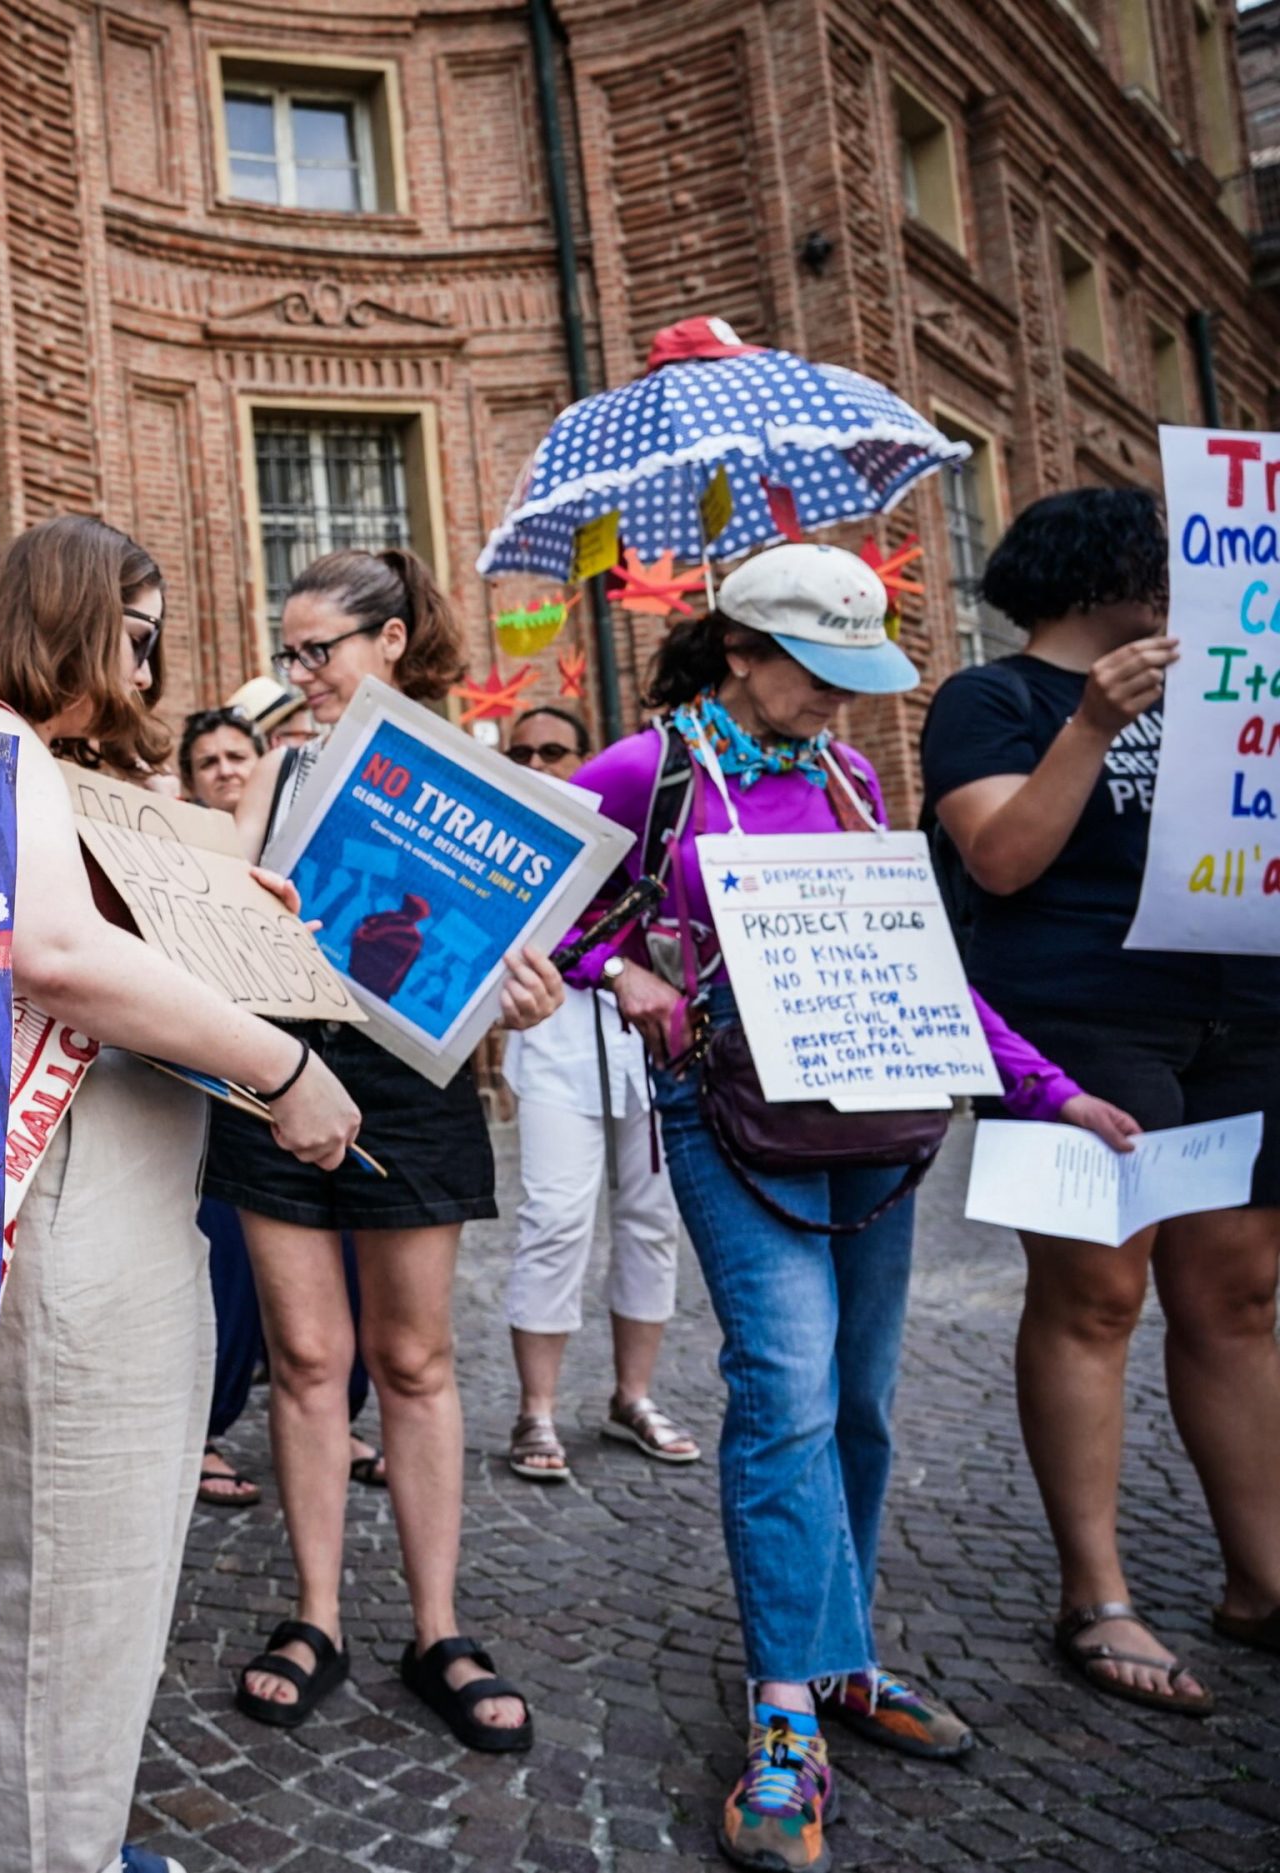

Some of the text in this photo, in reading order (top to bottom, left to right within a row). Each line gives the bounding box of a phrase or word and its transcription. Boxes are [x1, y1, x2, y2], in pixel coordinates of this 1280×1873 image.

[361, 752, 553, 887] NO TYRANTS
[78, 784, 210, 895] NO
[352, 785, 533, 903] GLOBAL DAY OF DEFIANCE JUNE 14
[865, 866, 928, 882] ABROAD
[742, 910, 849, 940] PROJECT
[122, 879, 348, 1008] KINGS
[763, 942, 879, 966] NO KINGS
[773, 963, 919, 991] NO TYRANTS
[783, 990, 900, 1015] RESPECT FOR
[844, 1010, 890, 1026] CIVIL
[792, 1023, 971, 1052] RESPECT FOR WOMEN
[836, 1042, 915, 1064] CONTROL
[803, 1062, 986, 1089] CLIMATE PROTECTION
